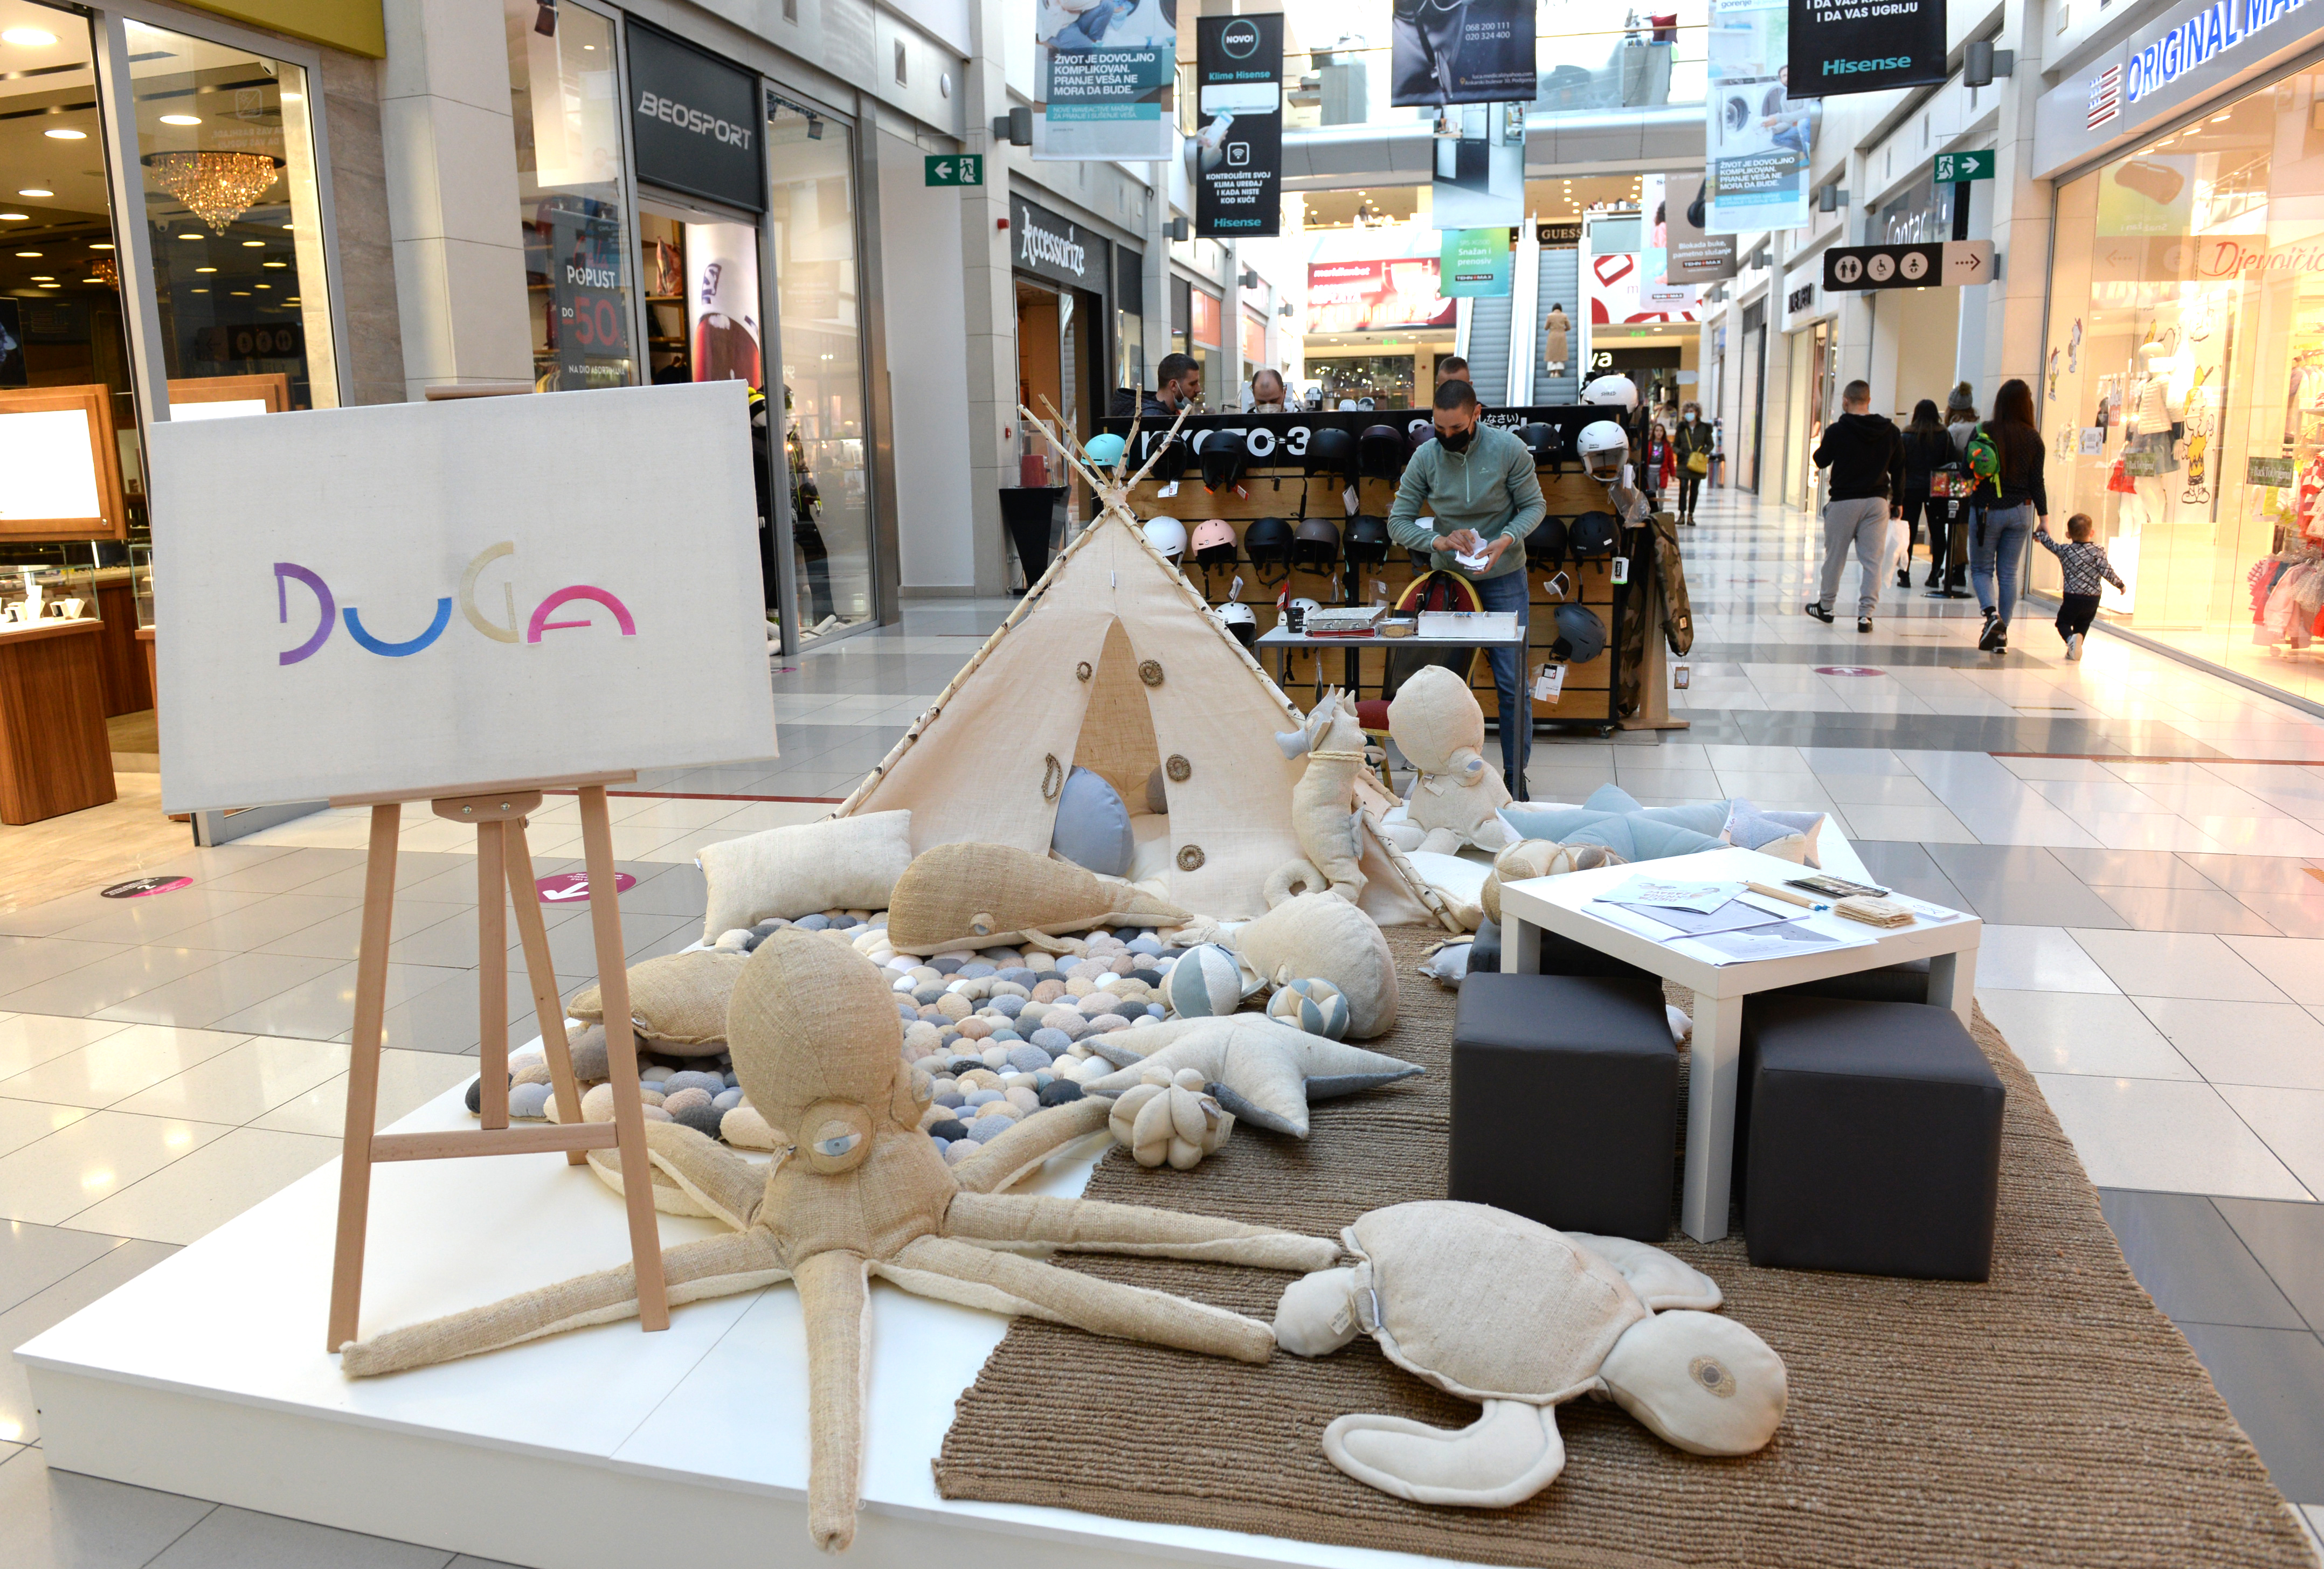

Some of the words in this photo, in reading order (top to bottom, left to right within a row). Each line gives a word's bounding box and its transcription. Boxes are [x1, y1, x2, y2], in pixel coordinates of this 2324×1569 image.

[1721, 0, 1752, 9] gorenje
[1807, 0, 1810, 9] I
[1814, 0, 1831, 9] DA
[1817, 12, 1821, 22] I
[1824, 11, 1842, 22] DA
[1844, 8, 1868, 19] VAS
[1872, 2, 1918, 16] UGRIJU
[1226, 34, 1254, 44] NOVO!
[2128, 0, 2244, 103] ORIGINAL
[1055, 53, 1084, 65] ŽIVOT
[1085, 54, 1098, 64] JE
[1099, 53, 1155, 64] DOVOLJNO
[1055, 64, 1130, 75] KOMPLIKOVAN.
[1822, 56, 1911, 76] Hisense
[1055, 75, 1094, 85] PRANJE
[1096, 73, 1122, 84] VEŠA
[1124, 74, 1138, 84] NE
[1209, 72, 1234, 80] Klime
[1236, 71, 1270, 79] Hisense
[1054, 86, 1084, 96] MORA
[1087, 86, 1101, 95] DA
[1103, 85, 1133, 95] BUDE.
[638, 91, 751, 150] BEOSPORT
[1720, 161, 1741, 169] ŽIVOT
[1753, 157, 1795, 166] DOVOLJNO
[1206, 171, 1251, 180] KONTROLIŠITE
[1720, 166, 1776, 176] KOMPLIKOVAN.
[1751, 172, 1770, 181] VEŠA
[1214, 218, 1261, 227] Hisense
[1541, 228, 1581, 240] GUESS
[1021, 206, 1084, 277] Accessorize
[1679, 242, 1706, 250] Blokada
[1458, 247, 1486, 255] Snažan
[1673, 250, 1704, 259] pametno
[1705, 247, 1732, 257] slušanje
[1457, 258, 1492, 267] prenosiv
[566, 265, 615, 289] POPUST
[562, 307, 573, 318] DO
[569, 365, 578, 373] NA
[579, 365, 590, 374] DIO
[591, 366, 625, 375] ASORTIMANA
[273, 540, 636, 665] DUGA
